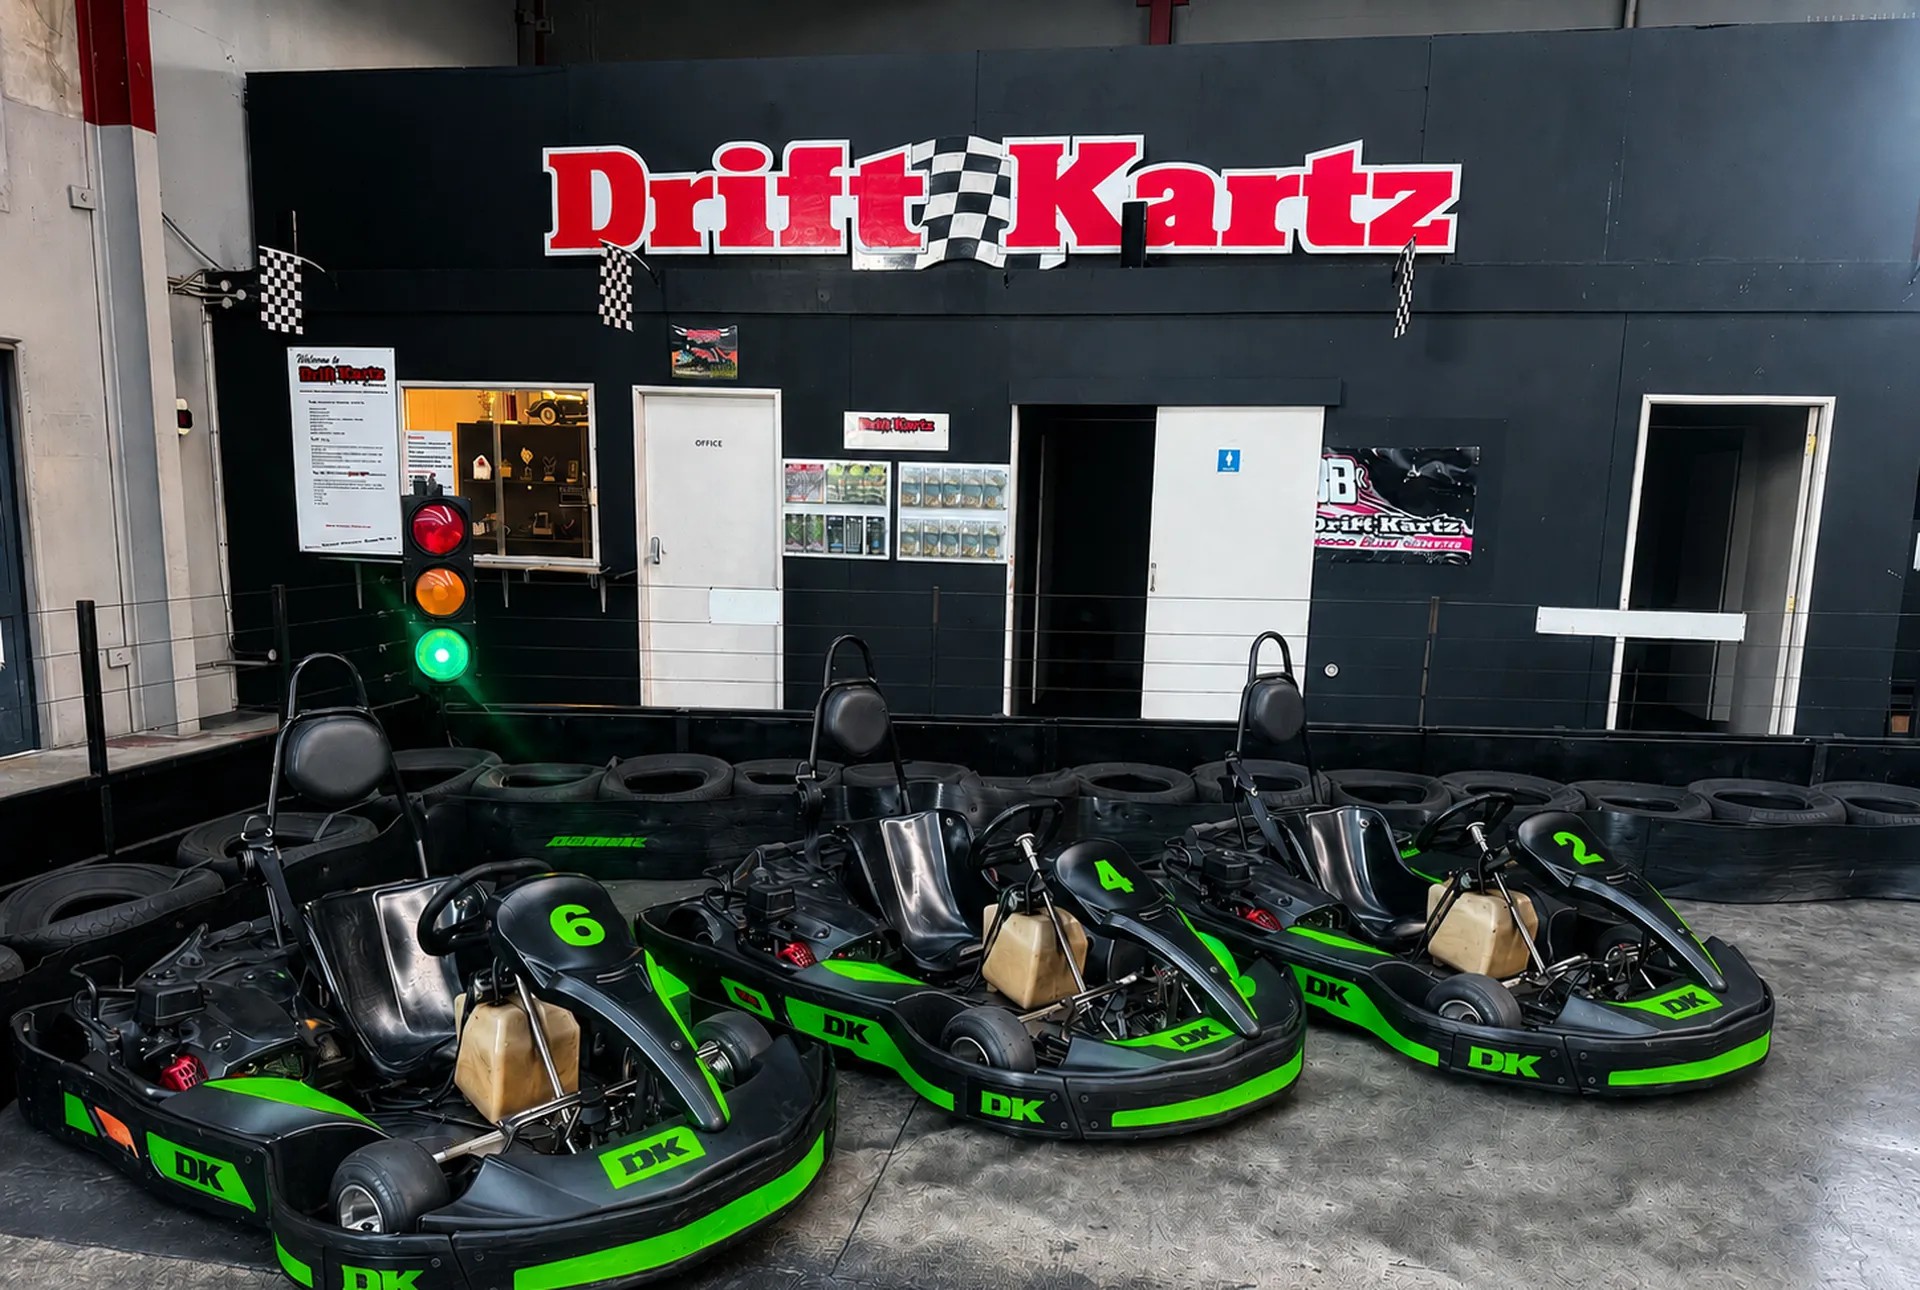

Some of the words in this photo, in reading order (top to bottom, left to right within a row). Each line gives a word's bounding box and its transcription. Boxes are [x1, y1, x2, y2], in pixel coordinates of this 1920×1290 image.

[545, 142, 929, 252] Drift
[1002, 138, 1458, 251] Kartz
[1379, 517, 1461, 533] Kartz
[1552, 831, 1605, 866] 2
[1094, 859, 1135, 893] 4
[549, 903, 606, 947] 6
[1304, 974, 1351, 1007] DK
[1660, 991, 1710, 1015] DK
[823, 1013, 871, 1046] DK
[1170, 1025, 1222, 1047] DK
[1467, 1045, 1542, 1079] DK
[980, 1090, 1045, 1124] DK
[174, 1150, 225, 1192] DK
[619, 1135, 691, 1176] DK
[341, 1264, 424, 1290] DK
